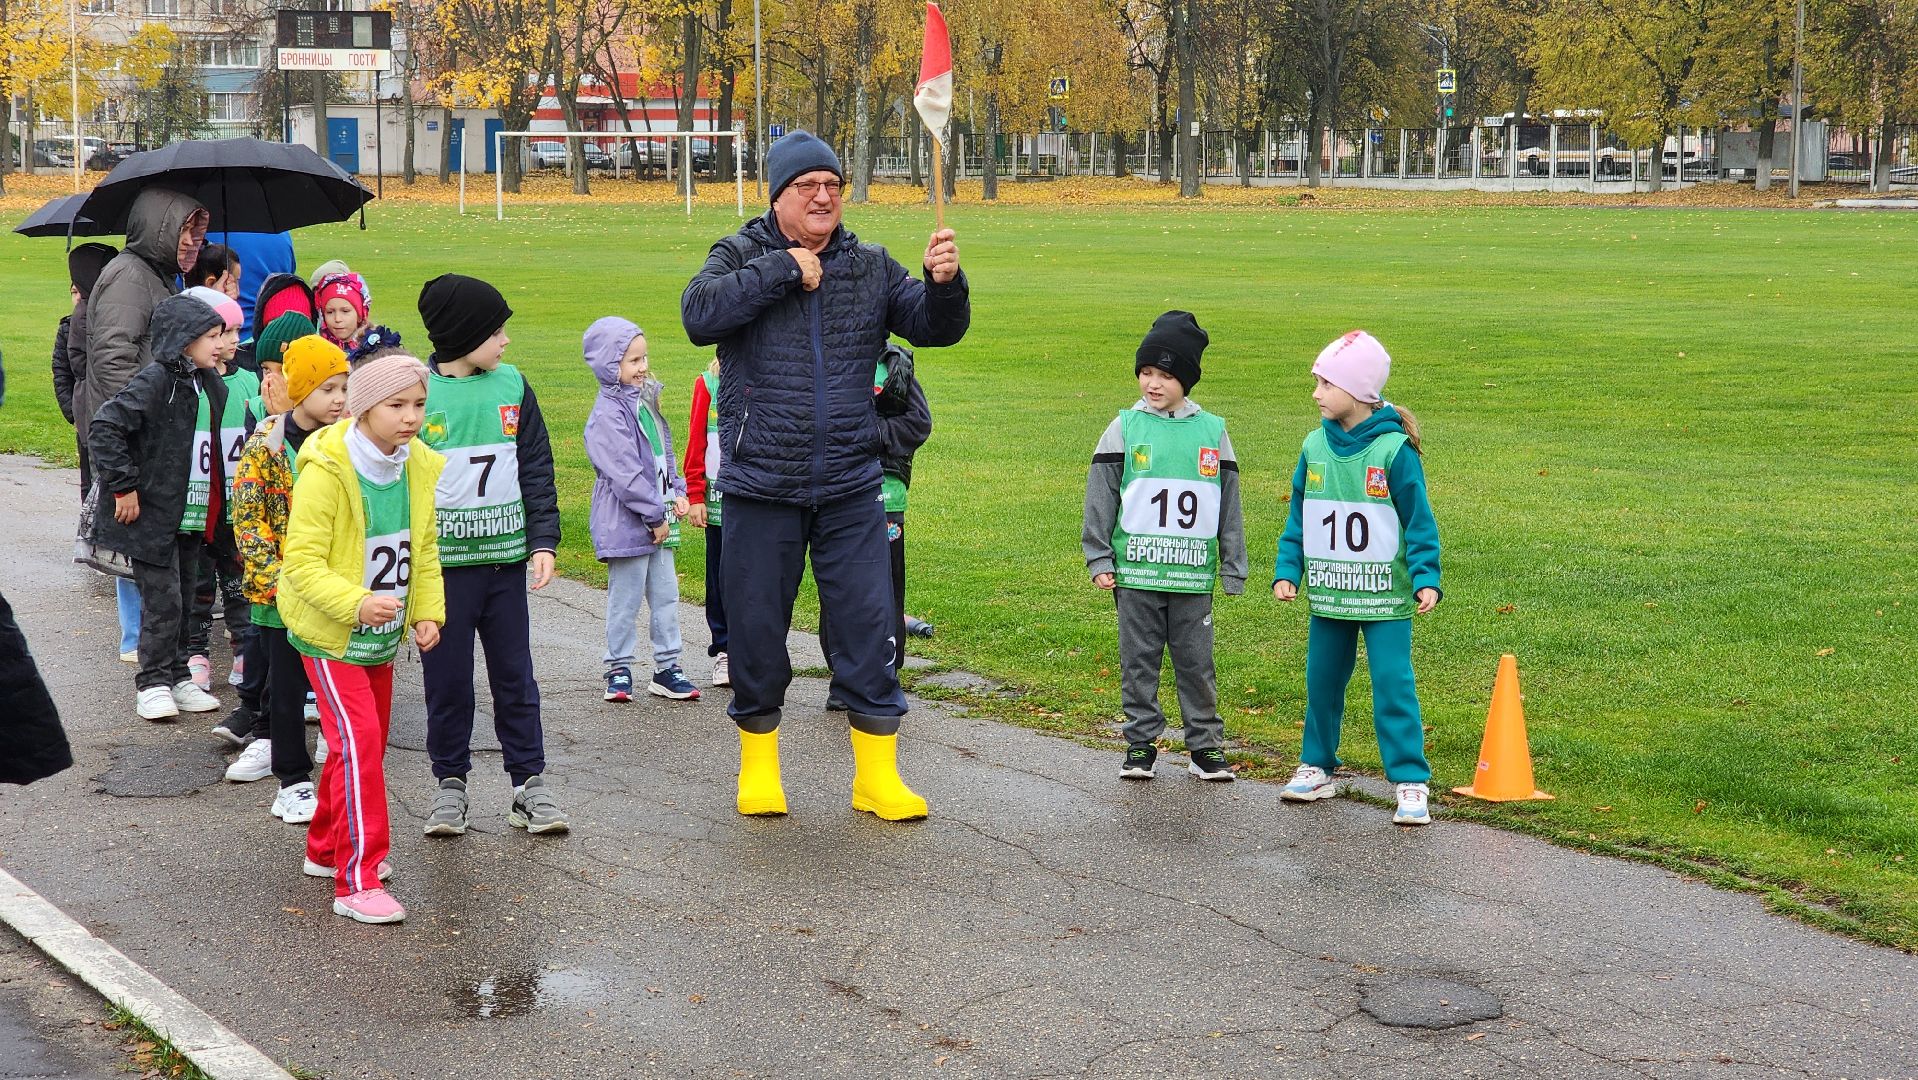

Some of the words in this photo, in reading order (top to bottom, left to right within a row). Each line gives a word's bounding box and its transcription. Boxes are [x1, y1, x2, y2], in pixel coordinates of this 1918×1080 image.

[281, 53, 332, 66] БРОННИЦЫ
[349, 54, 376, 66] ГОСТИ
[200, 440, 210, 475] 6
[228, 434, 244, 462] 4
[469, 454, 496, 497] 7
[1150, 488, 1198, 529] 19
[1127, 536, 1189, 549] СПОРТИВНЫЙ
[1190, 539, 1207, 550] КЛУБ
[1322, 510, 1369, 552] 10
[370, 540, 411, 591] 26
[1126, 545, 1208, 567] БРОННИЦЫ
[1308, 560, 1362, 574] СПОРТИВНЫЙ
[1364, 563, 1392, 575] КЛУБ
[1308, 569, 1392, 593] БРОННИЦЫ
